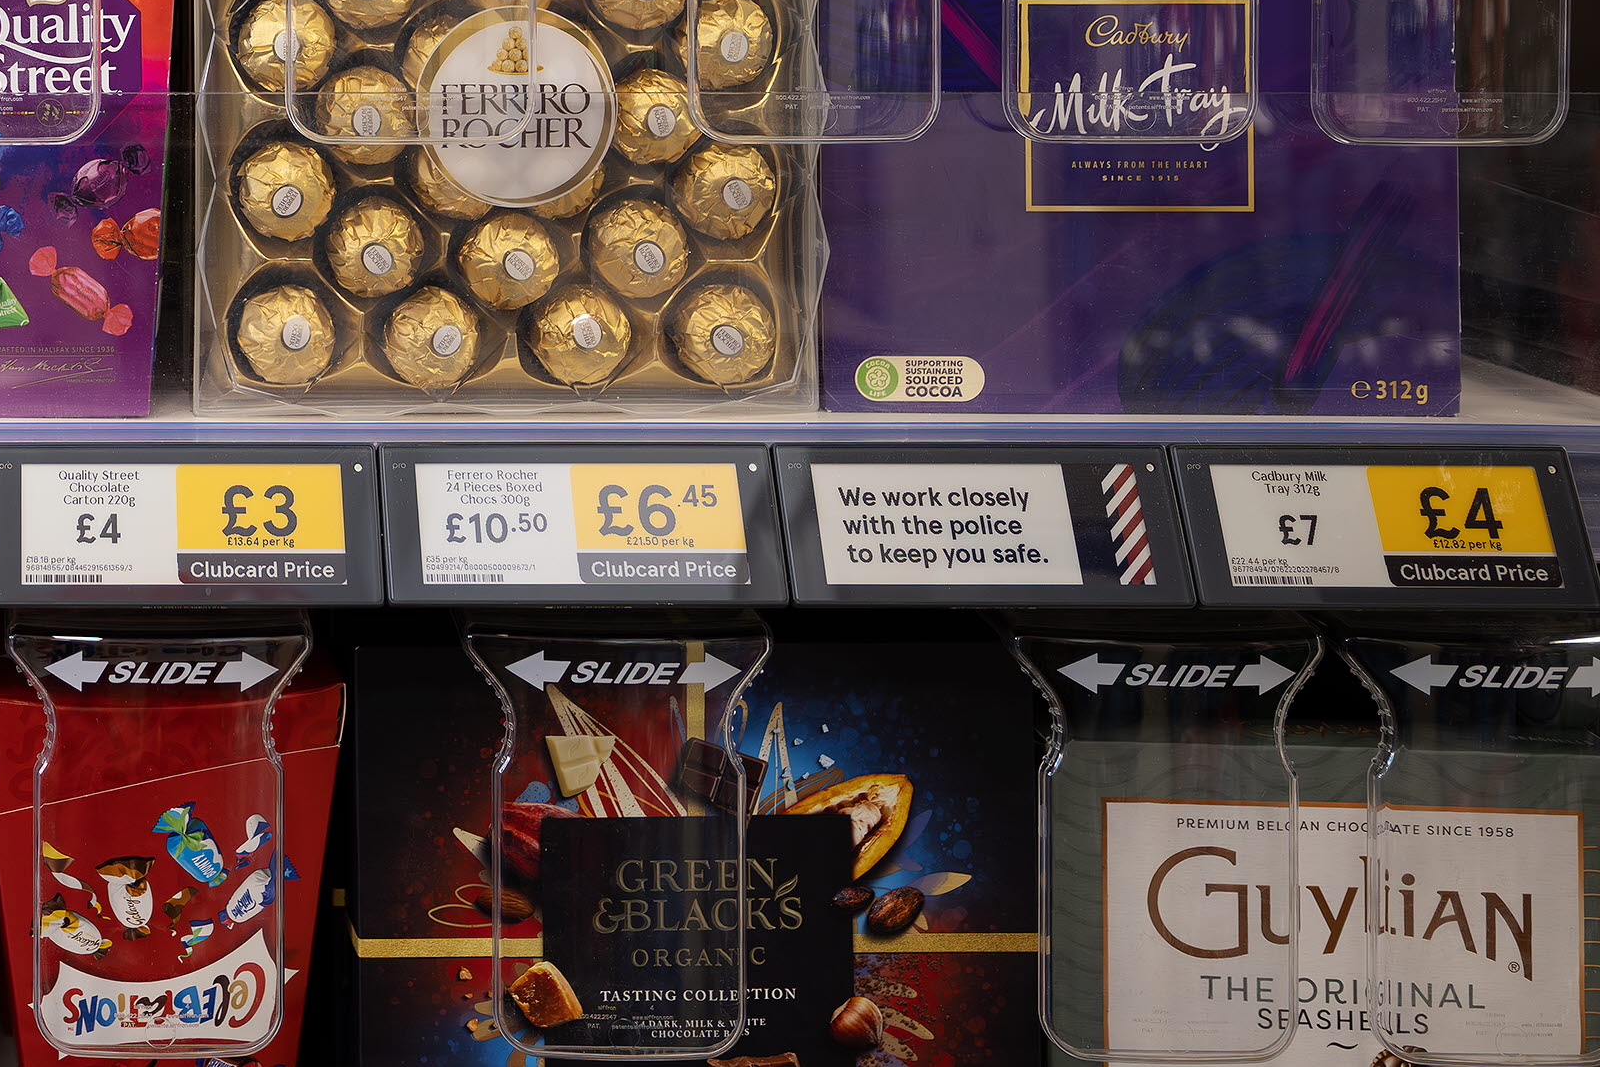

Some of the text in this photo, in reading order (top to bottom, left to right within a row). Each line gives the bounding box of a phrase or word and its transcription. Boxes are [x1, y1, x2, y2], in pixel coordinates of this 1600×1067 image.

[1085, 15, 1188, 53] Cadbury
[441, 83, 591, 115] FERRERO
[441, 118, 592, 148] ROCHER
[1071, 161, 1112, 169] ALWAYS
[905, 376, 963, 385] SOURCED
[905, 386, 962, 397] COCOA
[58, 470, 140, 483] Quality Street
[69, 482, 130, 493] Chocolate
[1251, 469, 1328, 485] Cadbury Milk
[63, 494, 136, 508] Carton 220g
[838, 486, 1030, 512] We work closely
[1264, 483, 1321, 497] Tray 312g
[222, 485, 298, 537] £3
[597, 485, 718, 537] £6.45
[1419, 486, 1504, 539] £4
[76, 513, 122, 545] £4
[446, 512, 548, 545] £10.50
[843, 515, 1023, 540] with the police
[227, 536, 295, 549] £13.64 per kg
[847, 543, 1050, 570] to keep you safe.
[190, 561, 335, 579] Clubcard Price
[108, 660, 217, 684] SLIDE
[570, 661, 680, 685] SLIDE
[1125, 663, 1235, 688] SLIDE
[1458, 664, 1568, 689] SLIDE
[1177, 817, 1515, 838] PREMIUM SINCE 1958
[616, 858, 778, 893] GREEN
[601, 989, 676, 1002] TASTING
[1200, 975, 1274, 1003] THE
